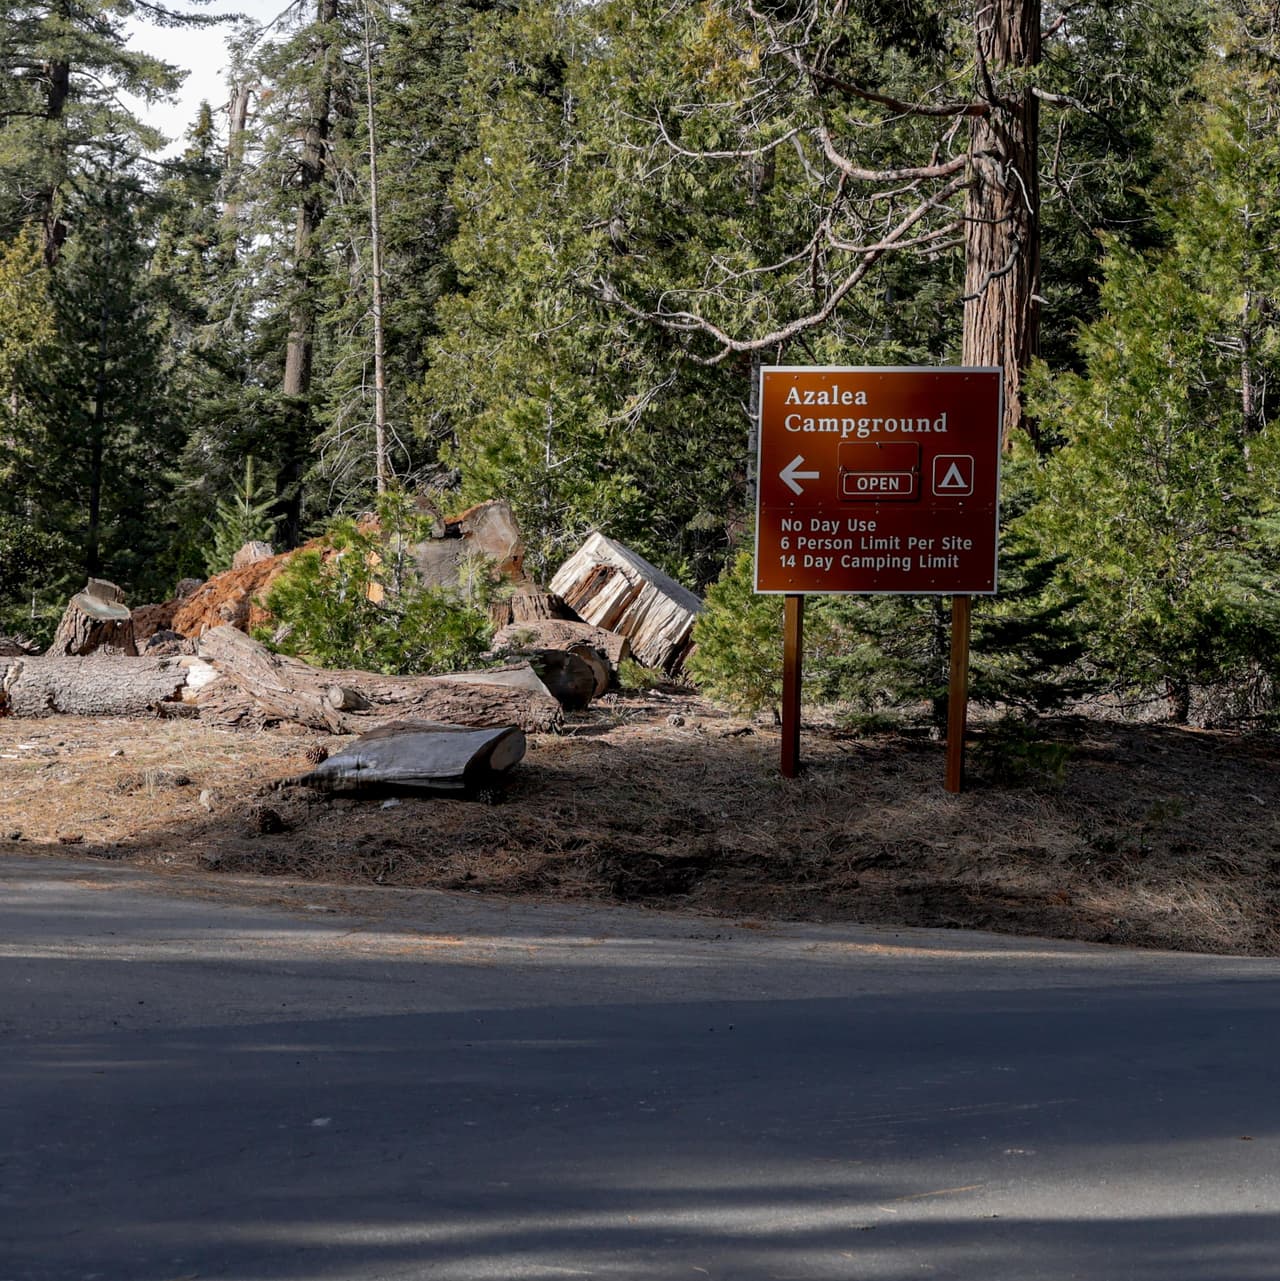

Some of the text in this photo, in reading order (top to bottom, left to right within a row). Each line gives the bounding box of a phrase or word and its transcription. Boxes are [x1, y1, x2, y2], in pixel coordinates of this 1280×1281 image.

[784, 385, 868, 406] Azalea
[784, 412, 948, 438] Campground
[856, 477, 900, 491] OPEN
[781, 518, 877, 535] No Day Use
[780, 535, 973, 550] 6 Person Limit Per Site
[779, 554, 959, 572] 14 Day Camping Limit
